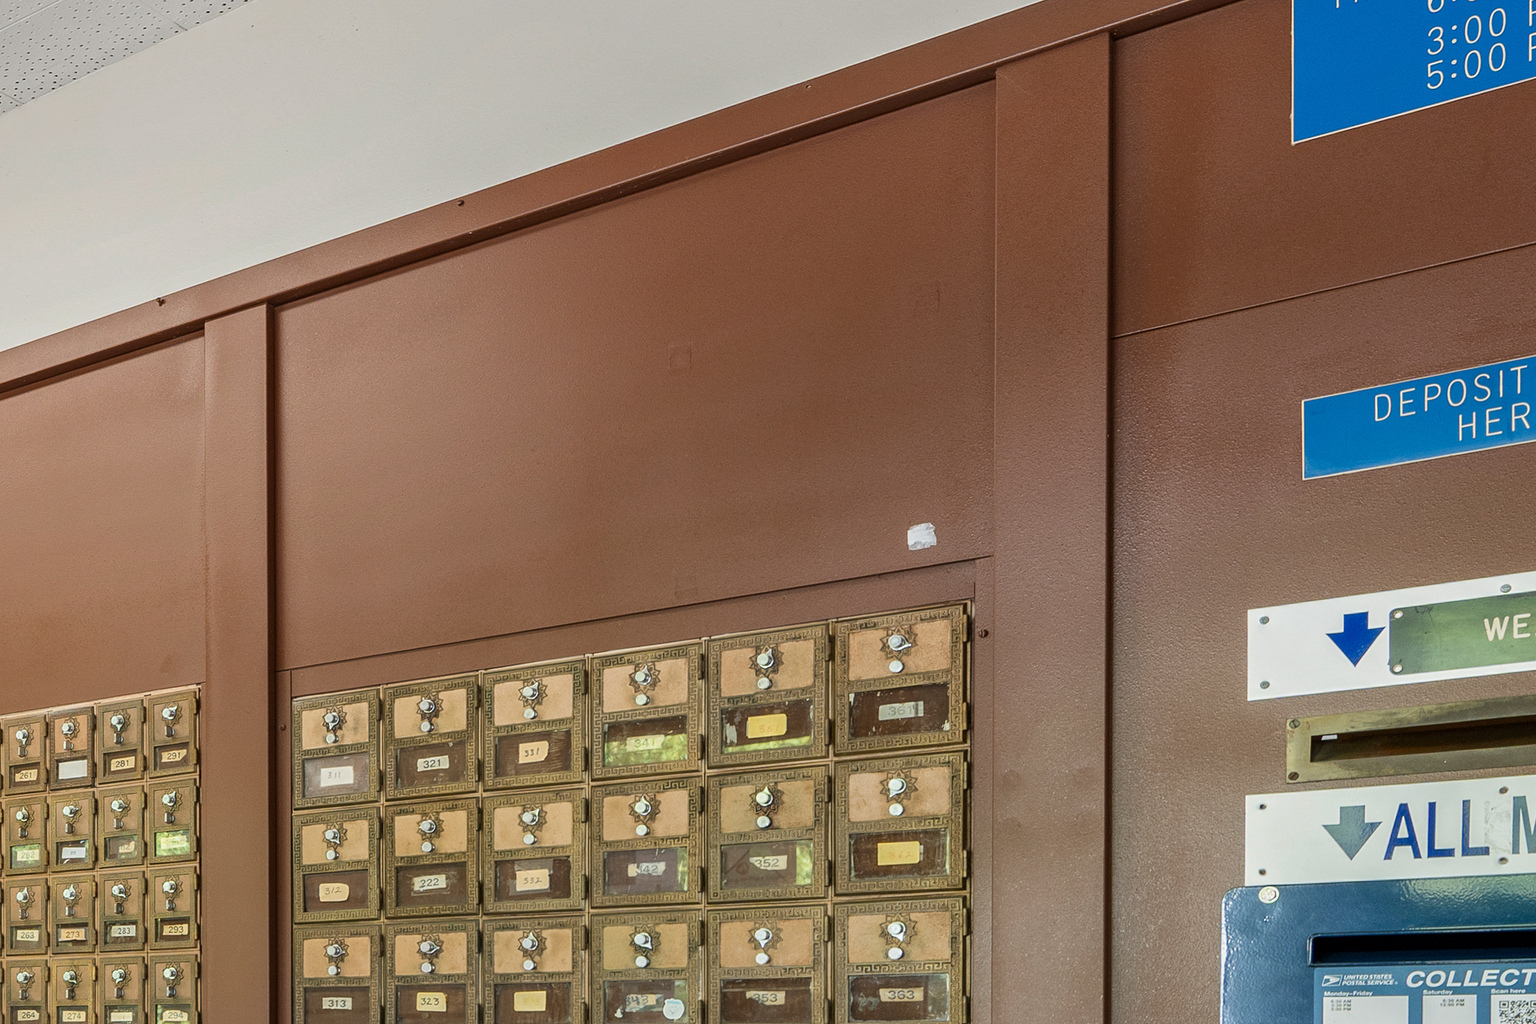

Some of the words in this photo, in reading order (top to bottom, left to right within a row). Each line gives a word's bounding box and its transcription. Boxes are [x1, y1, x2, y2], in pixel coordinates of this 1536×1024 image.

[1427, 8, 1507, 55] 3:00
[1427, 43, 1506, 89] 5:00
[1374, 365, 1528, 422] DEPOSIT
[887, 705, 913, 716] 361
[635, 738, 656, 748] 341
[423, 758, 441, 768] 321
[327, 770, 341, 780] 311
[1383, 799, 1490, 861] ALL
[754, 858, 779, 868] 352
[324, 887, 342, 895] 312
[753, 992, 778, 1002] 353
[888, 990, 914, 1000] 363
[328, 999, 346, 1007] 313
[421, 997, 440, 1005] 323
